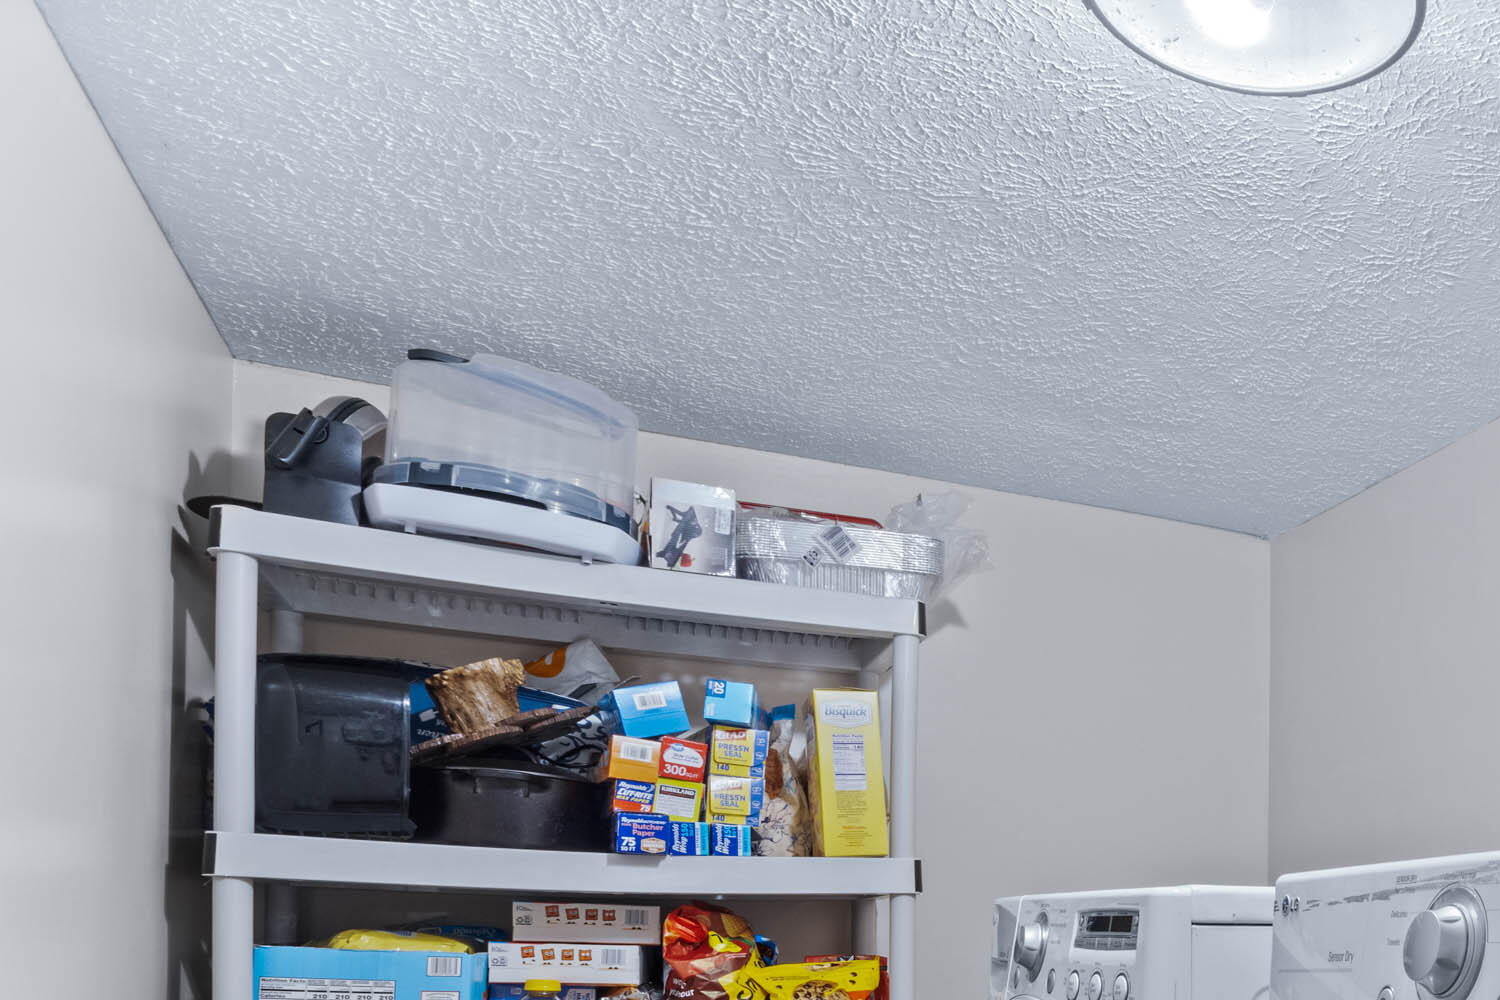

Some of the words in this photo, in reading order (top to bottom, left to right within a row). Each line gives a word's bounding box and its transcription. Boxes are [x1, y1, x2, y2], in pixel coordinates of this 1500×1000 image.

[714, 681, 725, 694] 20
[724, 750, 743, 759] SEAL
[664, 763, 687, 776] 300
[632, 822, 664, 831] Butcher
[632, 829, 655, 837] Paper
[621, 836, 636, 846] 75
[672, 824, 681, 852] Reynolds
[1290, 897, 1300, 912] LG
[1328, 951, 1344, 962] Sensor
[1344, 950, 1354, 963] Dry
